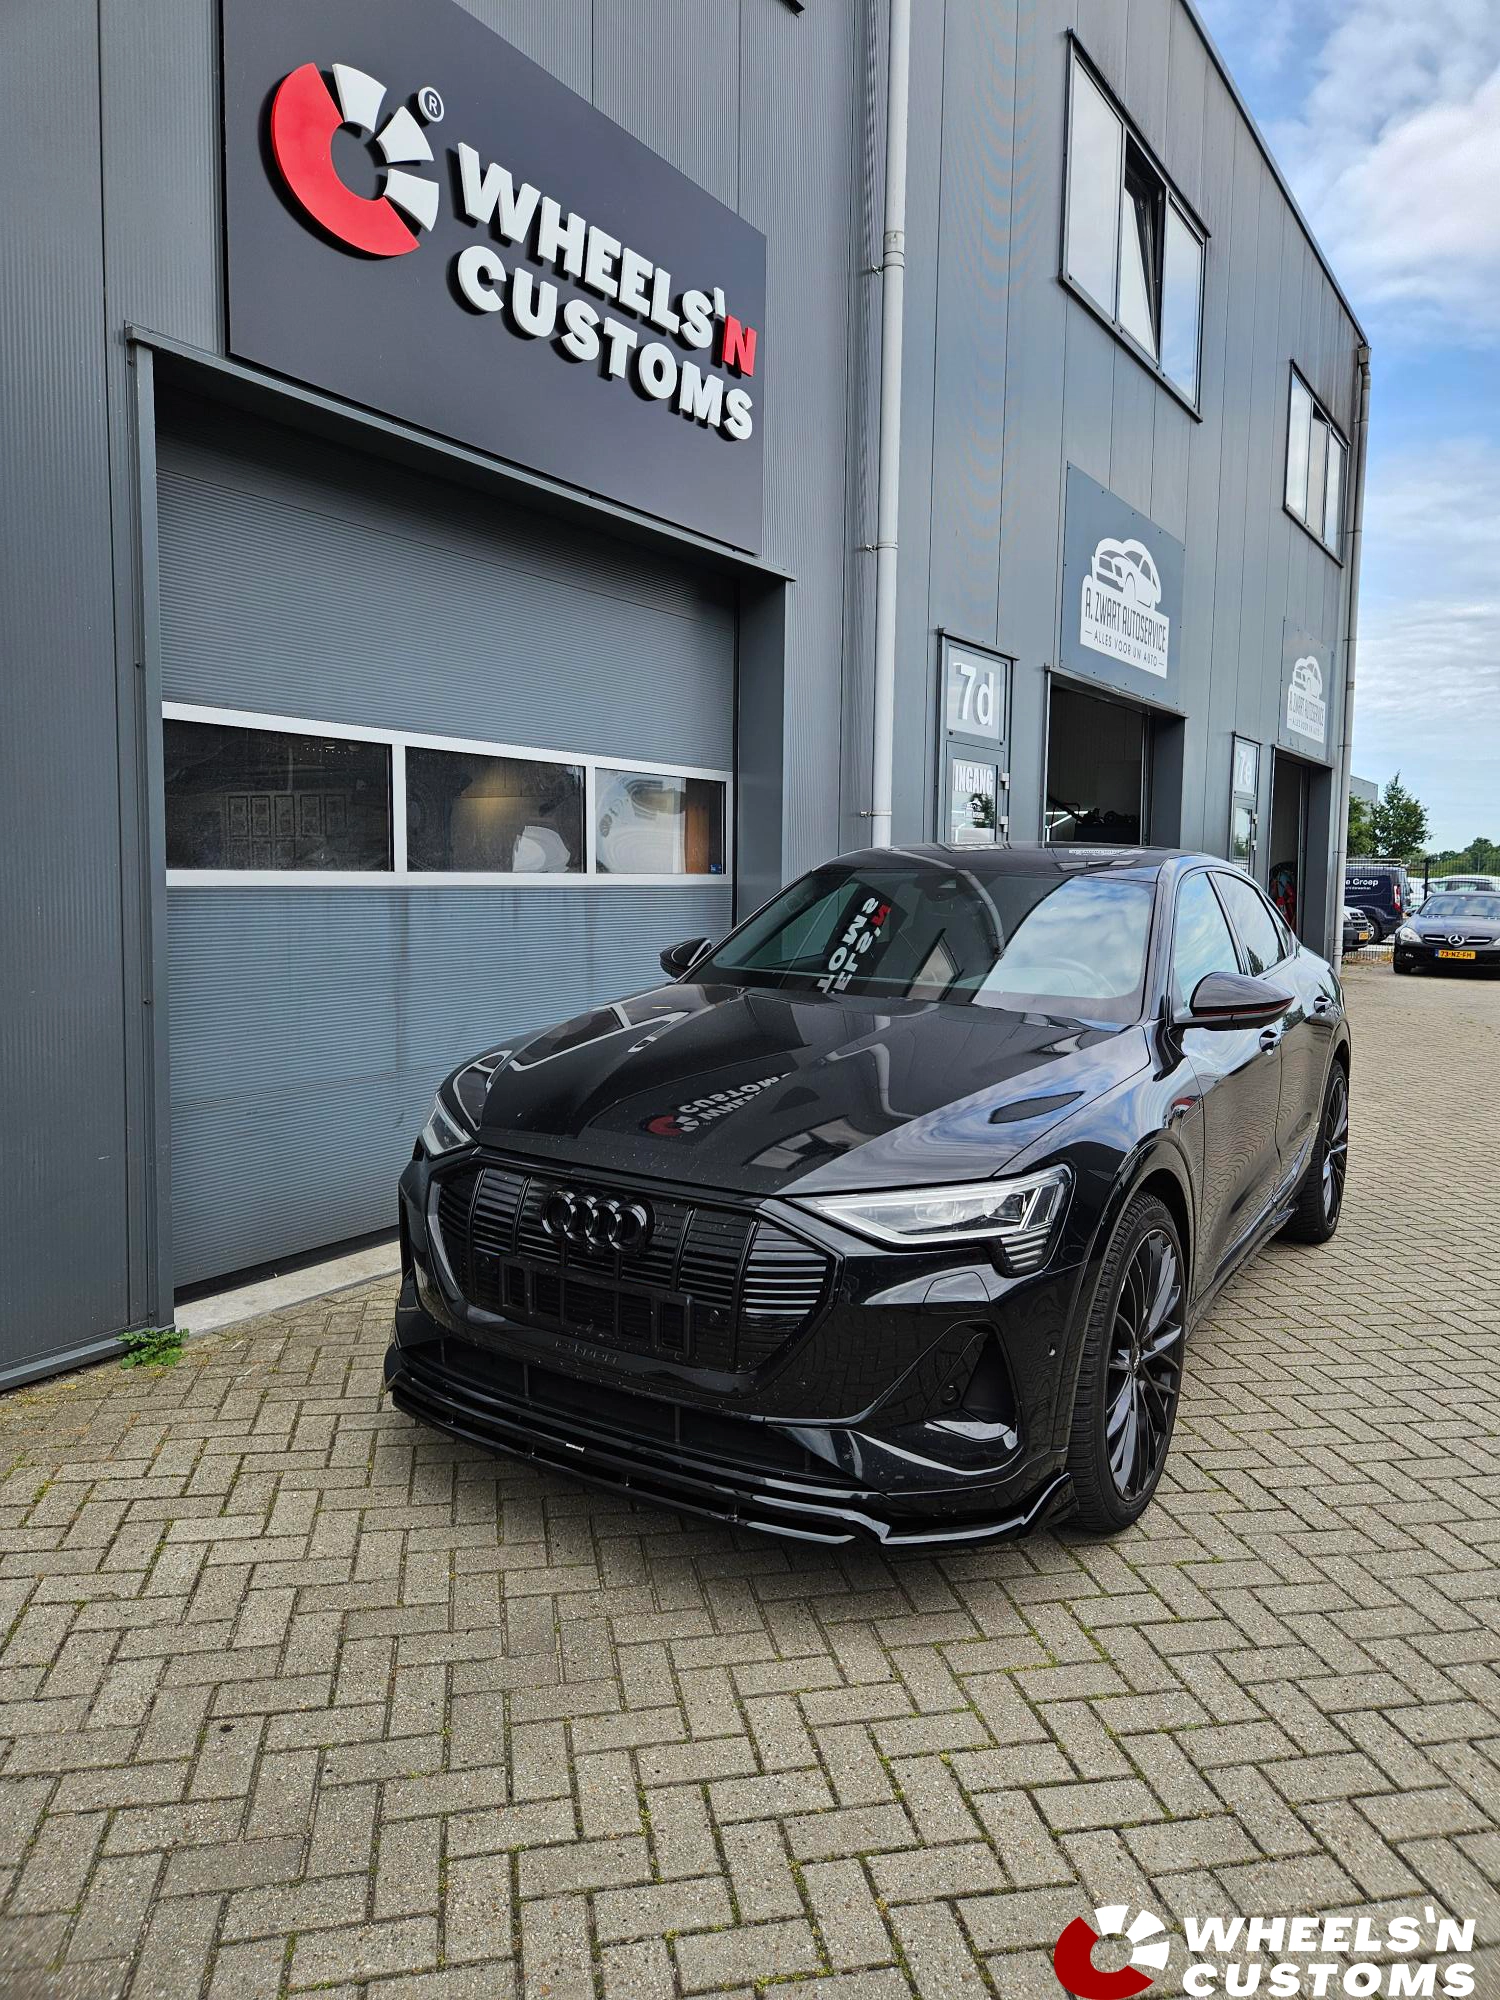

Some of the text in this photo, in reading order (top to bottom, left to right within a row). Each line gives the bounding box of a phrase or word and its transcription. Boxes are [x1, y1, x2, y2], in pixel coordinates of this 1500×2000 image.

[458, 142, 757, 377] WHEELS'N
[458, 245, 753, 440] CUSTOMS
[1085, 587, 1166, 653] A. ZWART AUTOSERVICE
[1094, 630, 1111, 647] ALLES
[1114, 638, 1131, 656] VOOR
[953, 662, 995, 726] 7d
[953, 764, 994, 794] INGANG
[1352, 878, 1379, 887] Groep
